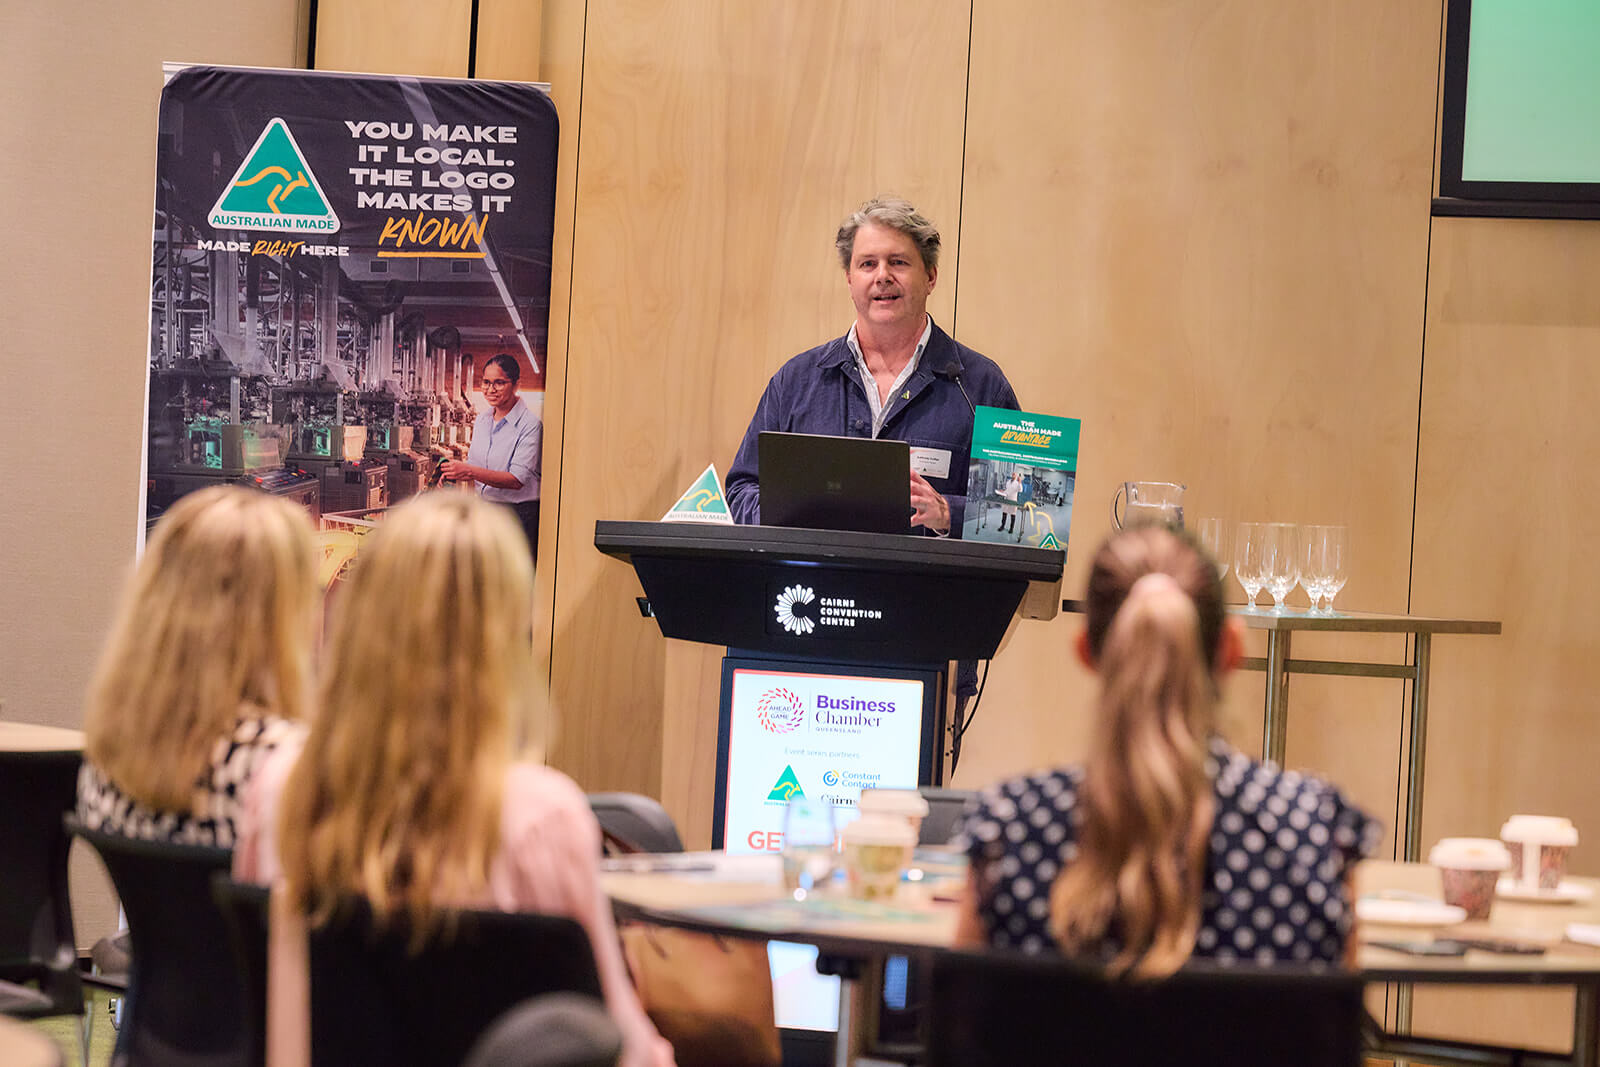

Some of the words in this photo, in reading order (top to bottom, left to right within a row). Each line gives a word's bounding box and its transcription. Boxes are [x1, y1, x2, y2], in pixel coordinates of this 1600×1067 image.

[344, 121, 413, 140] YOU
[422, 123, 518, 143] MAKE
[358, 145, 388, 162] IT
[396, 146, 515, 167] LOCAL.
[349, 168, 413, 187] THE
[422, 170, 515, 190] LOGO
[357, 191, 473, 212] MAKES
[482, 195, 511, 213] IT
[212, 215, 292, 228] AUSTRALIAN
[296, 219, 335, 230] MADE
[378, 211, 488, 250] KNOWN
[197, 240, 250, 252] MADE
[251, 240, 304, 258] RIGHT
[301, 245, 349, 256] HERE
[993, 422, 1039, 434] AUSTRALIAN
[1040, 428, 1062, 437] MADE
[1020, 420, 1035, 428] THE
[1001, 430, 1052, 445] ADVANTAGE
[820, 597, 855, 608] CAIRNS
[820, 607, 882, 619] CONVENTION
[820, 617, 855, 627] CENTRE
[769, 704, 792, 712] AHEAD
[816, 695, 896, 713] Business
[815, 711, 882, 727] Chamber
[842, 771, 880, 780] Constant
[842, 780, 876, 789] Contact
[747, 831, 785, 851] GE
